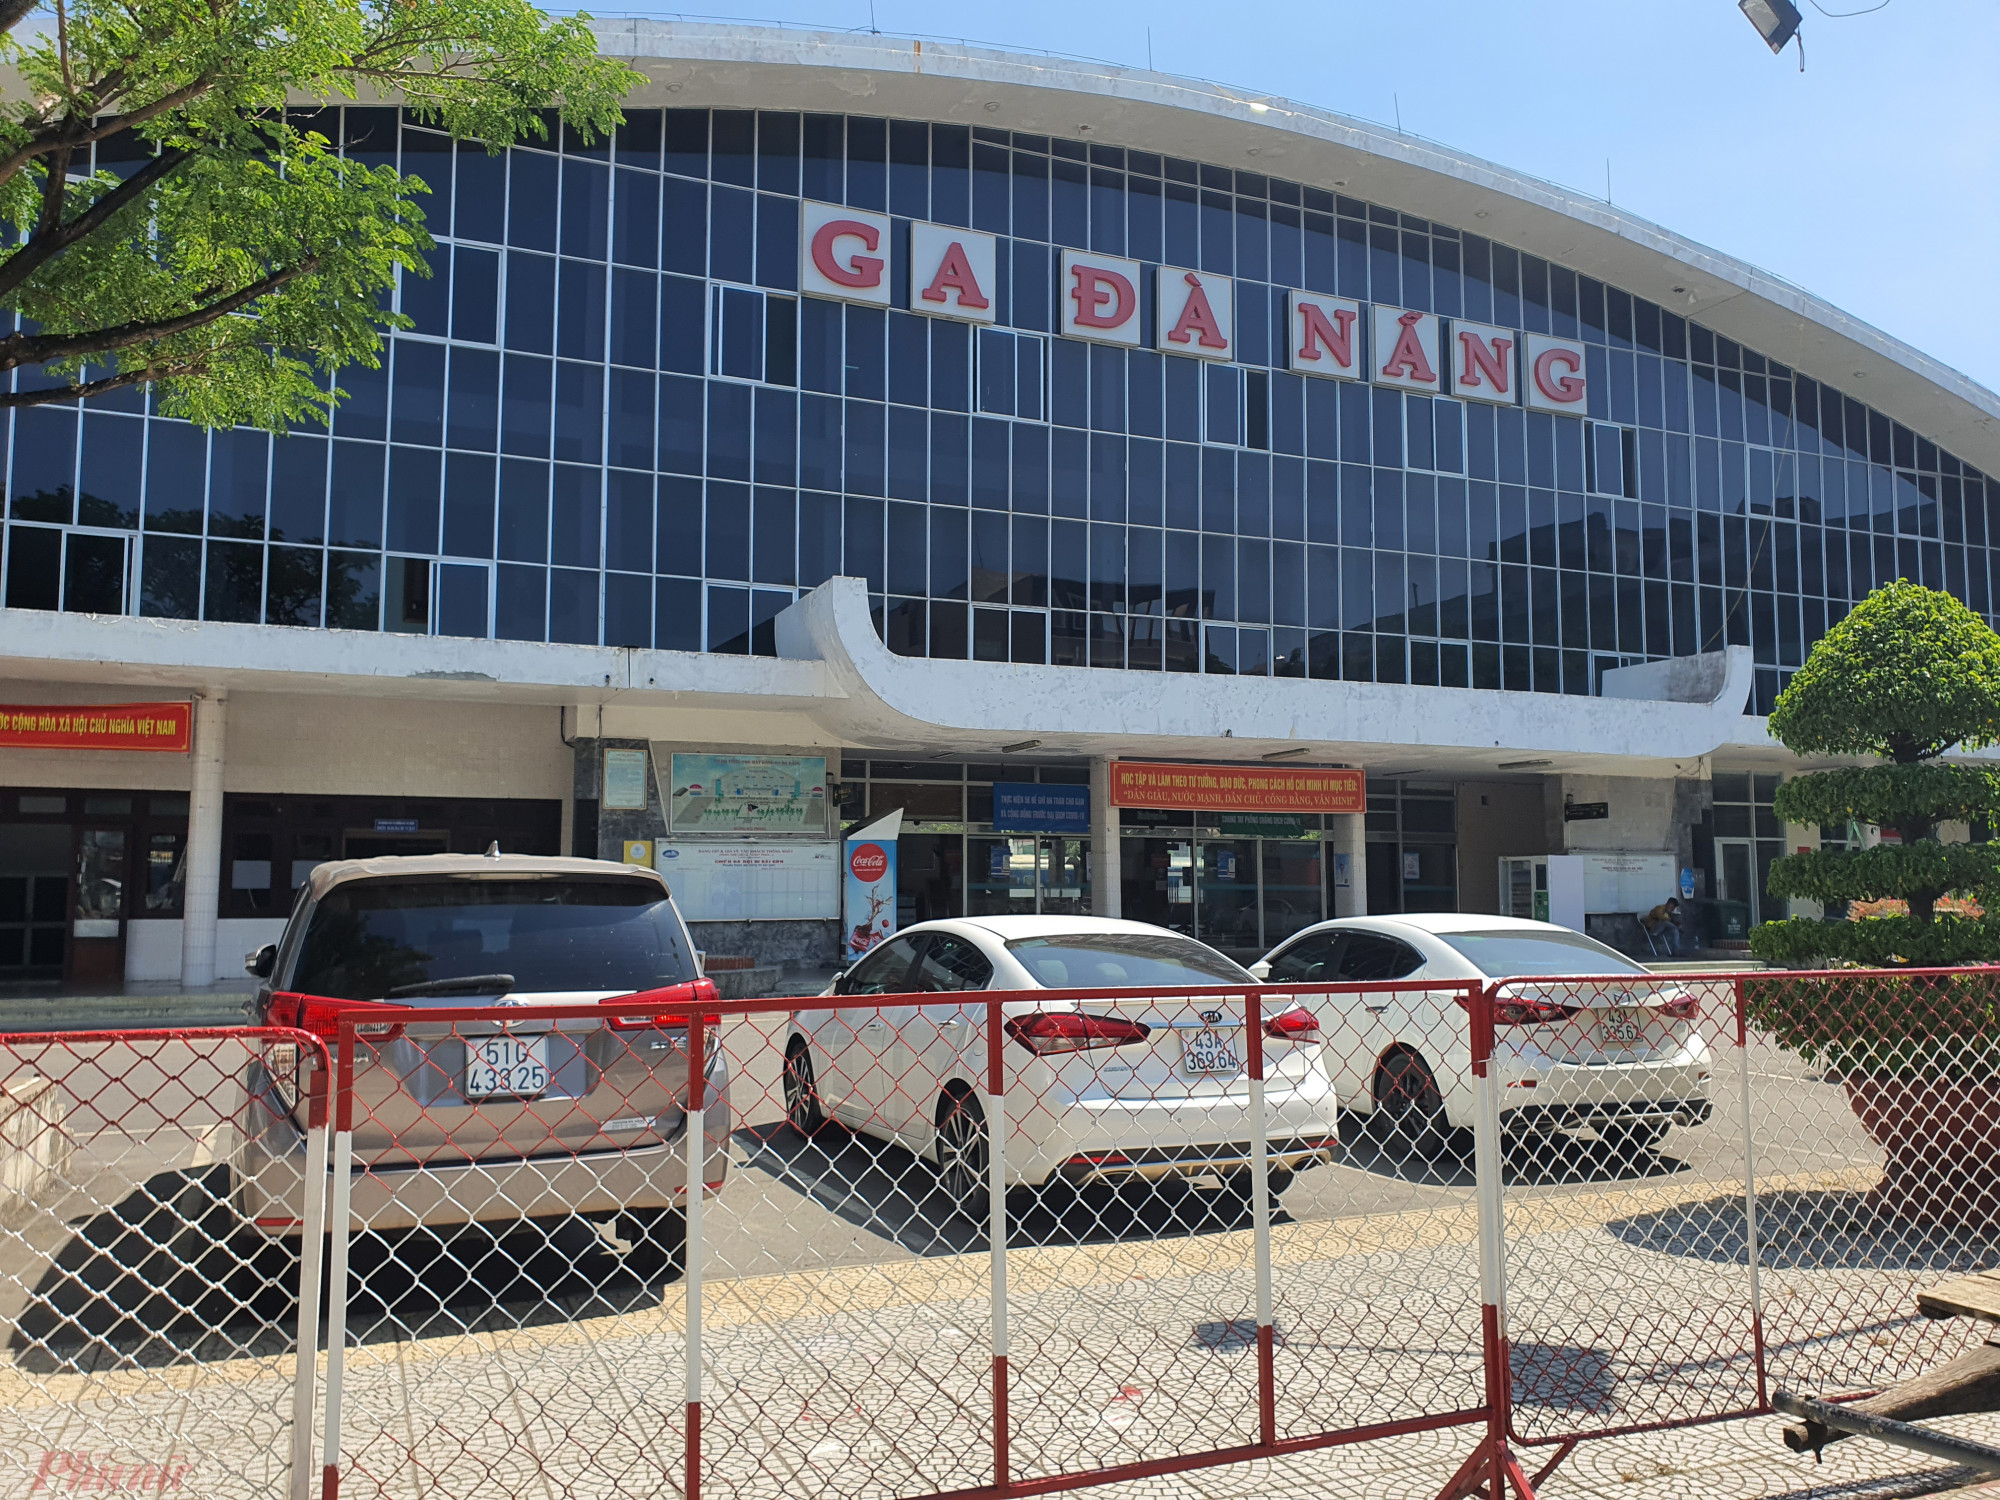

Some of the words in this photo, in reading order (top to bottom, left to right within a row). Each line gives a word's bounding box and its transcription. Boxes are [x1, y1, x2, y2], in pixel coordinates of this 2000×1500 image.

[812, 220, 989, 309] GA
[1072, 264, 1228, 349] ĐÀ
[12, 713, 36, 734] CỘNG
[58, 714, 70, 732] XÃ
[73, 714, 87, 736] HỘI
[90, 713, 107, 733] CHỦ
[109, 716, 134, 734] NGHĨA
[138, 716, 155, 738] VIỆT
[157, 720, 176, 735] NAM
[1121, 773, 1133, 787] HỌC
[1135, 771, 1146, 788] TẬP
[1148, 772, 1156, 785] VÀ
[1158, 772, 1170, 786] LÀM
[1172, 775, 1187, 787] THEO
[1189, 775, 1196, 788] TƯ
[1248, 777, 1268, 790] PHONG
[1270, 776, 1285, 791] CÁCH
[1287, 776, 1294, 791] HỒ
[1296, 777, 1305, 791] CHÍ
[1307, 780, 1321, 791] MINH
[1323, 777, 1329, 791] VÌ
[1330, 780, 1342, 793] MỤC
[1172, 790, 1195, 801] NƯỚC
[1265, 793, 1287, 804] CÔNG
[1203, 1012, 1220, 1021] KIA
[1196, 1030, 1222, 1049] 43A
[486, 1042, 527, 1065] 51G
[1187, 1051, 1236, 1070] 369.64
[470, 1067, 544, 1092] 433.25
